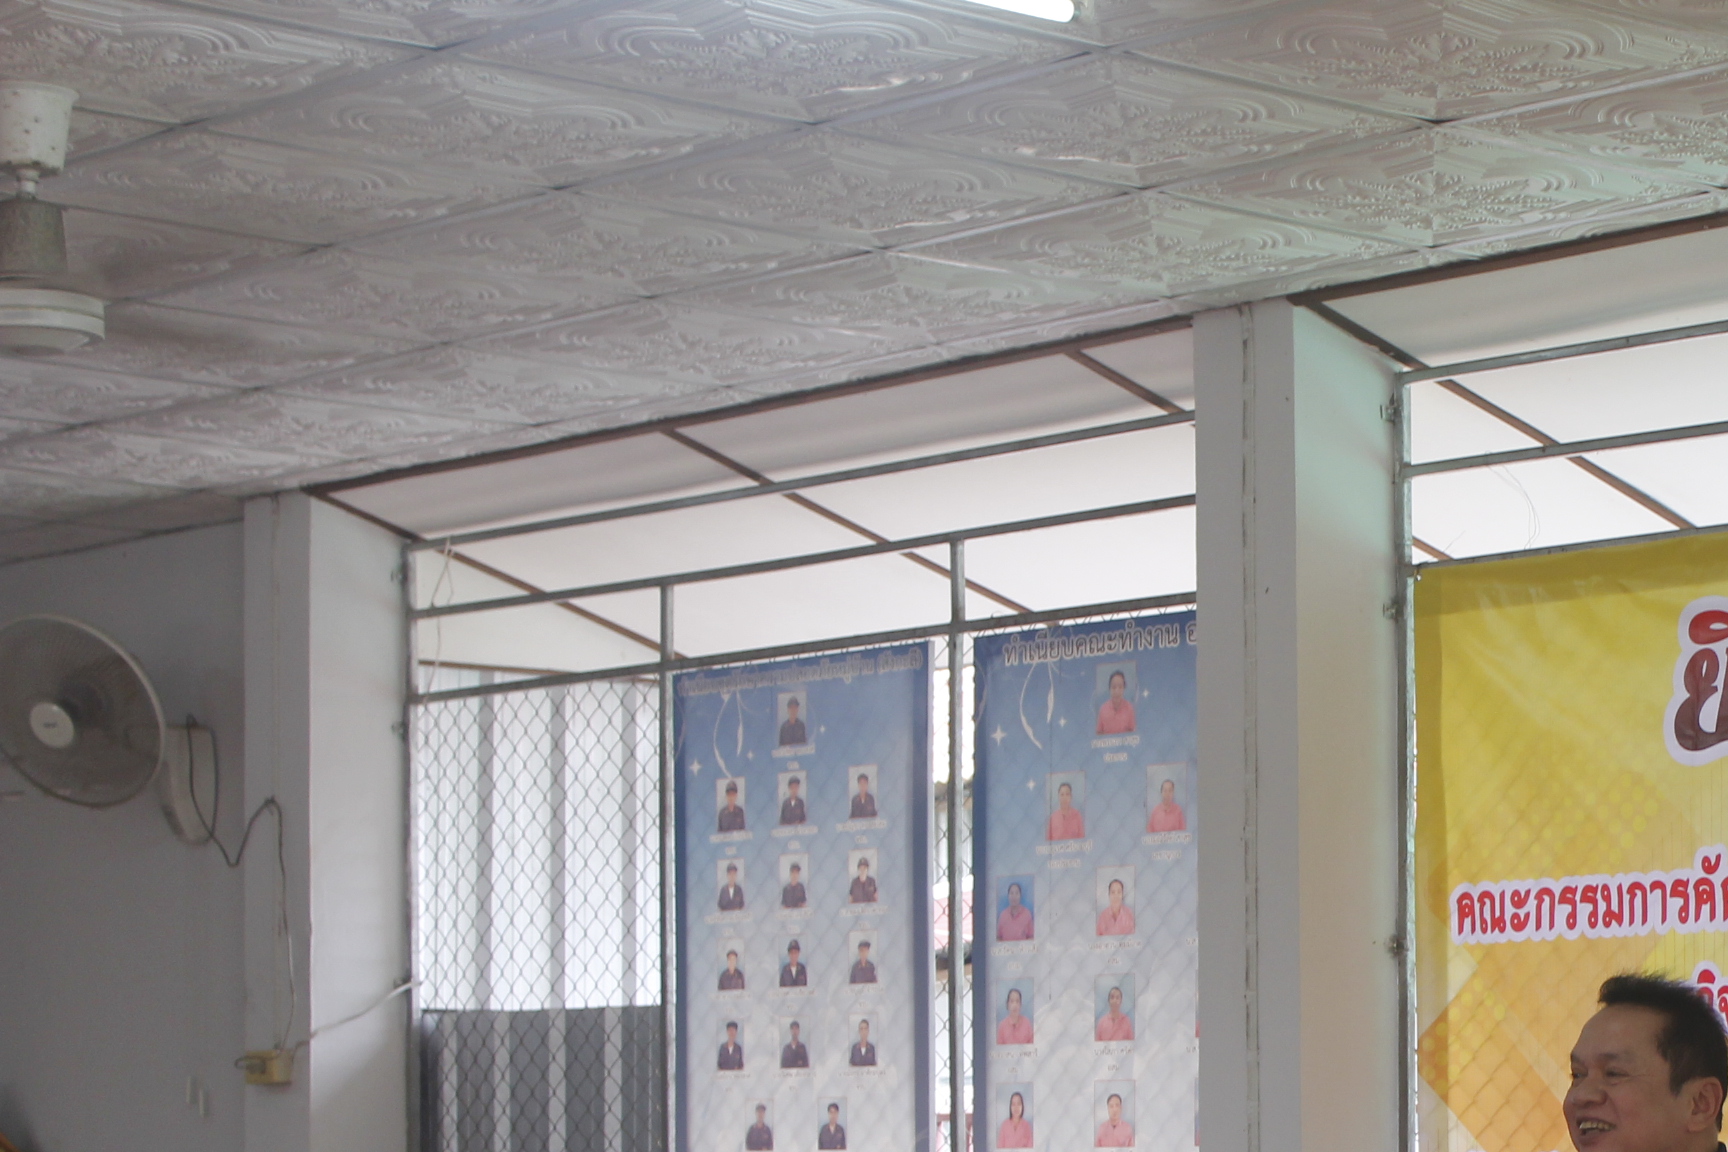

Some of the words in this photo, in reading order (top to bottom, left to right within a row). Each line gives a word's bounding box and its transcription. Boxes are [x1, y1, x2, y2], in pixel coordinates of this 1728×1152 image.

[1003, 620, 1180, 666] ทำเนียบคณะทำงาน
